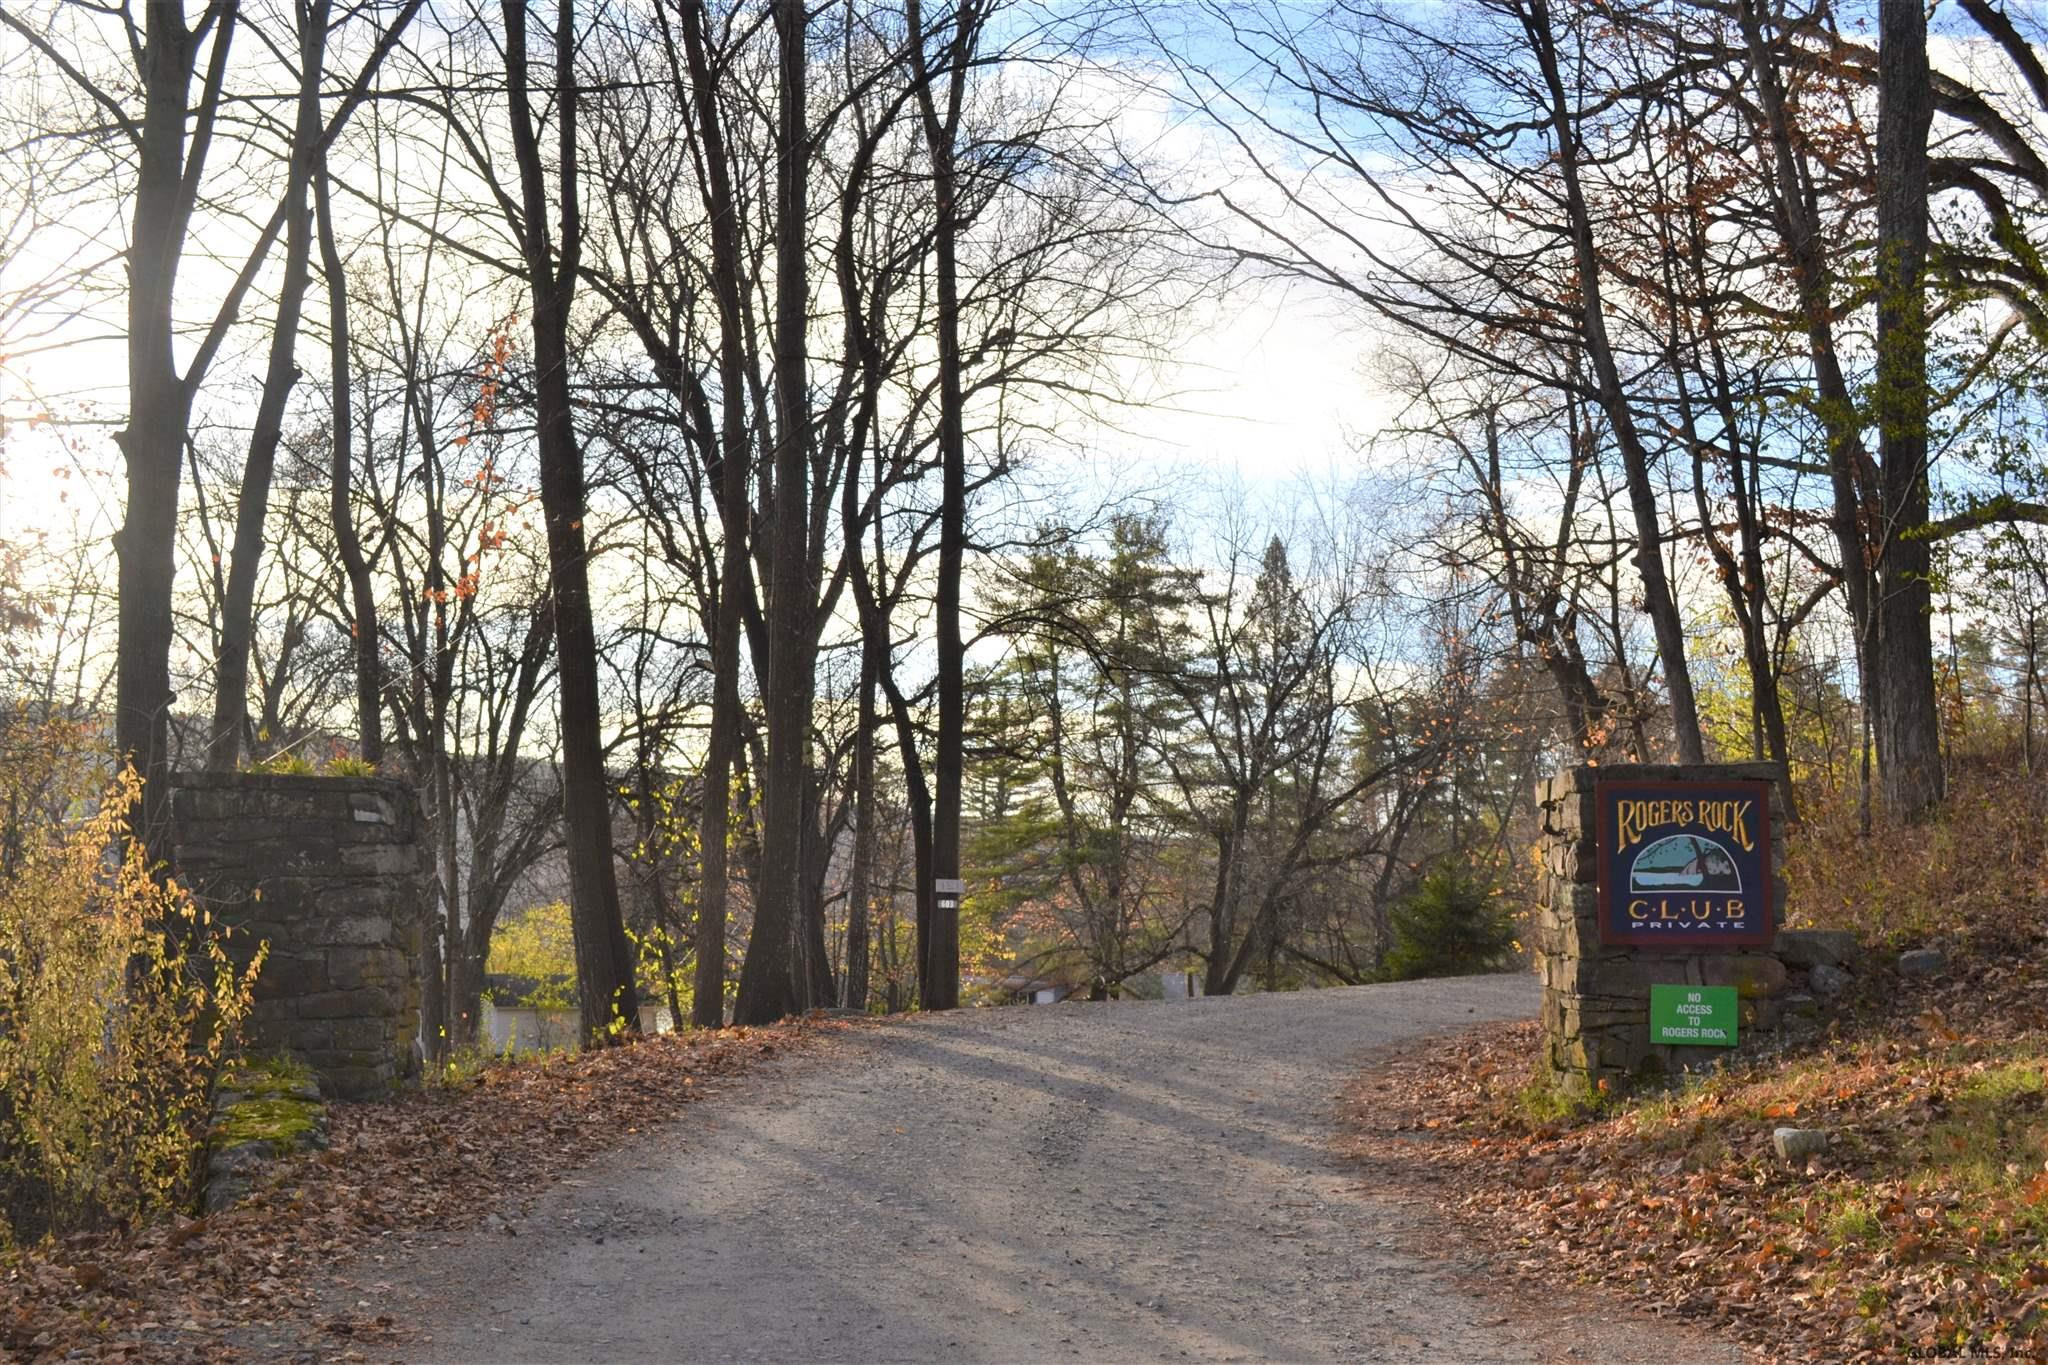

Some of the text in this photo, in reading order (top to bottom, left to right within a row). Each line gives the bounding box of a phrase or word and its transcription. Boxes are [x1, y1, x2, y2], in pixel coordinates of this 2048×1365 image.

[1617, 800, 1754, 854] ROGERS ROCK
[1687, 992, 1702, 1003] NO
[1676, 1004, 1713, 1015] ACCESS
[1688, 1016, 1701, 1026] TO
[1662, 1027, 1699, 1038] ROGERS
